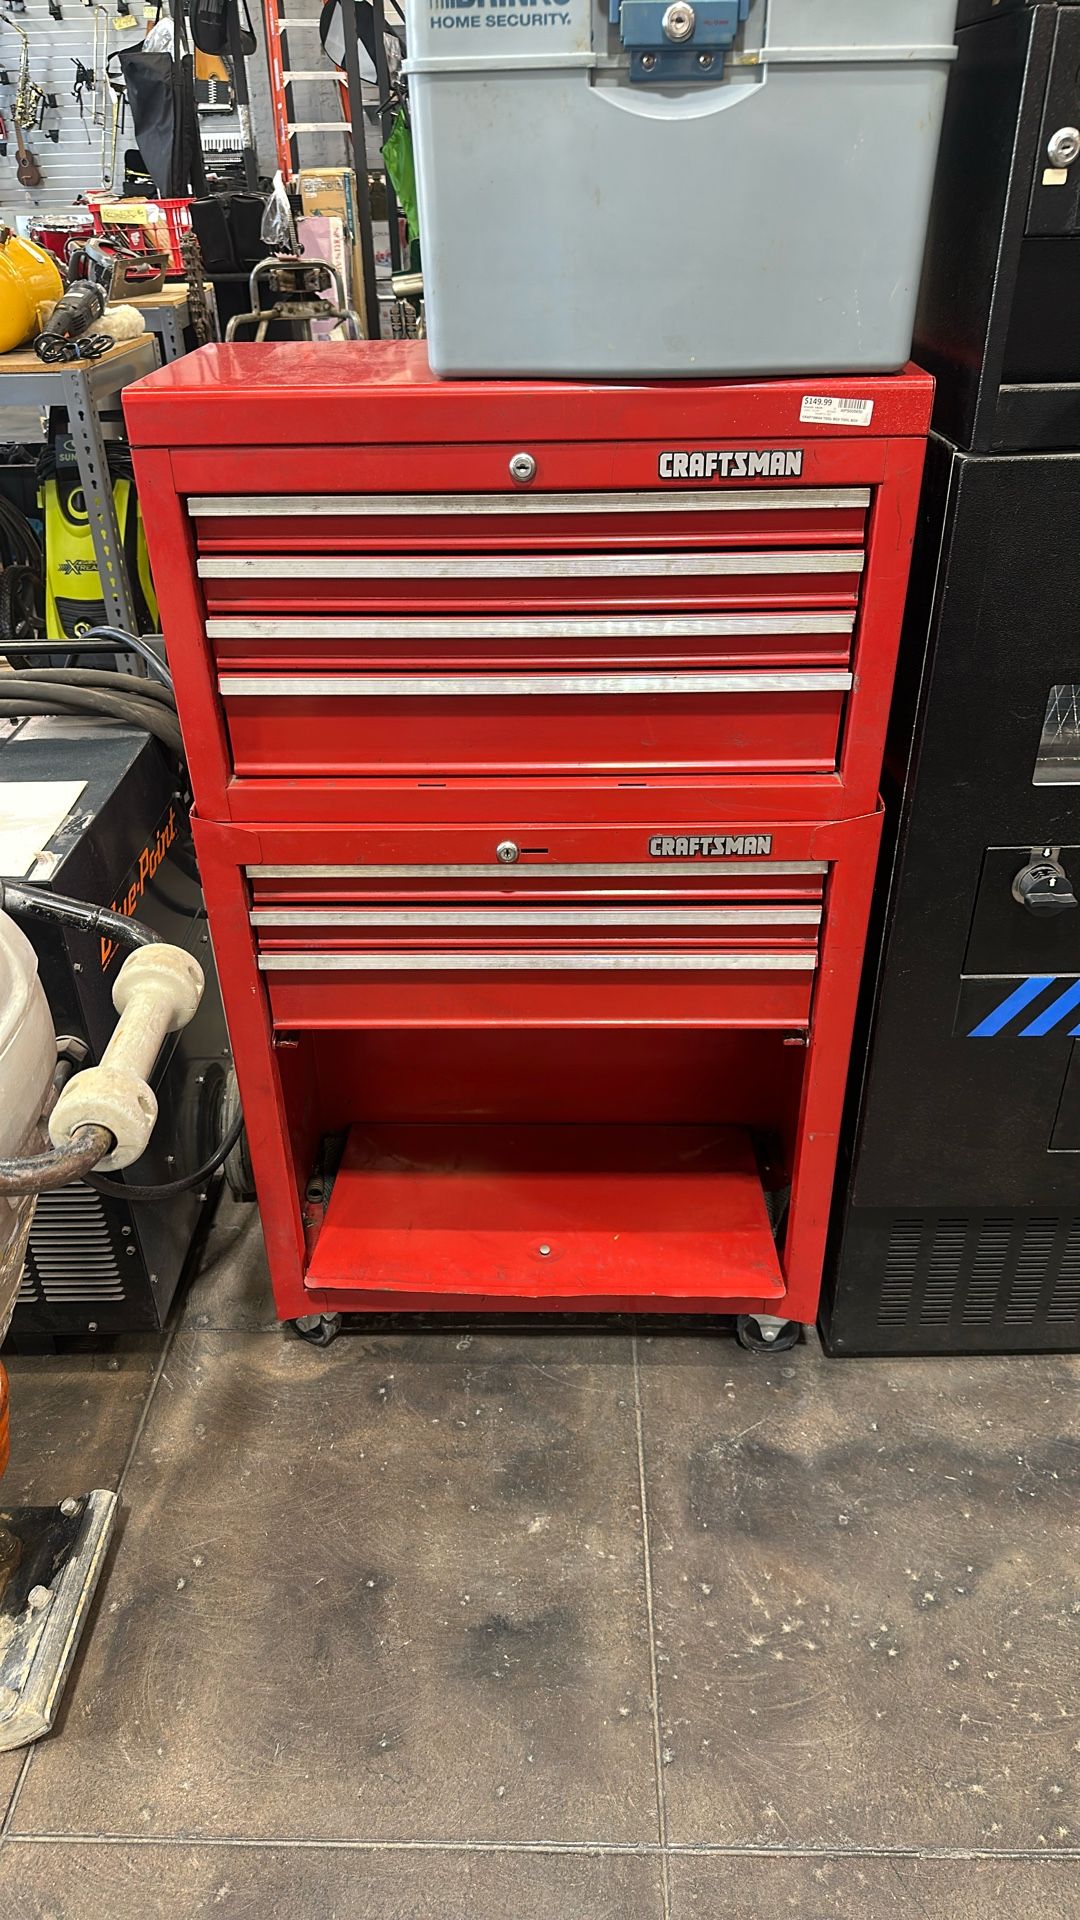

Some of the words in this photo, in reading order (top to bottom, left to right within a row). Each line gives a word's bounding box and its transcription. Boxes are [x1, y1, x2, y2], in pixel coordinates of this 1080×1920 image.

[430, 15, 481, 29] HOME
[804, 397, 833, 406] $149.99
[659, 450, 802, 478] CRAFTSMAN
[650, 836, 772, 856] CRAFTSMAN
